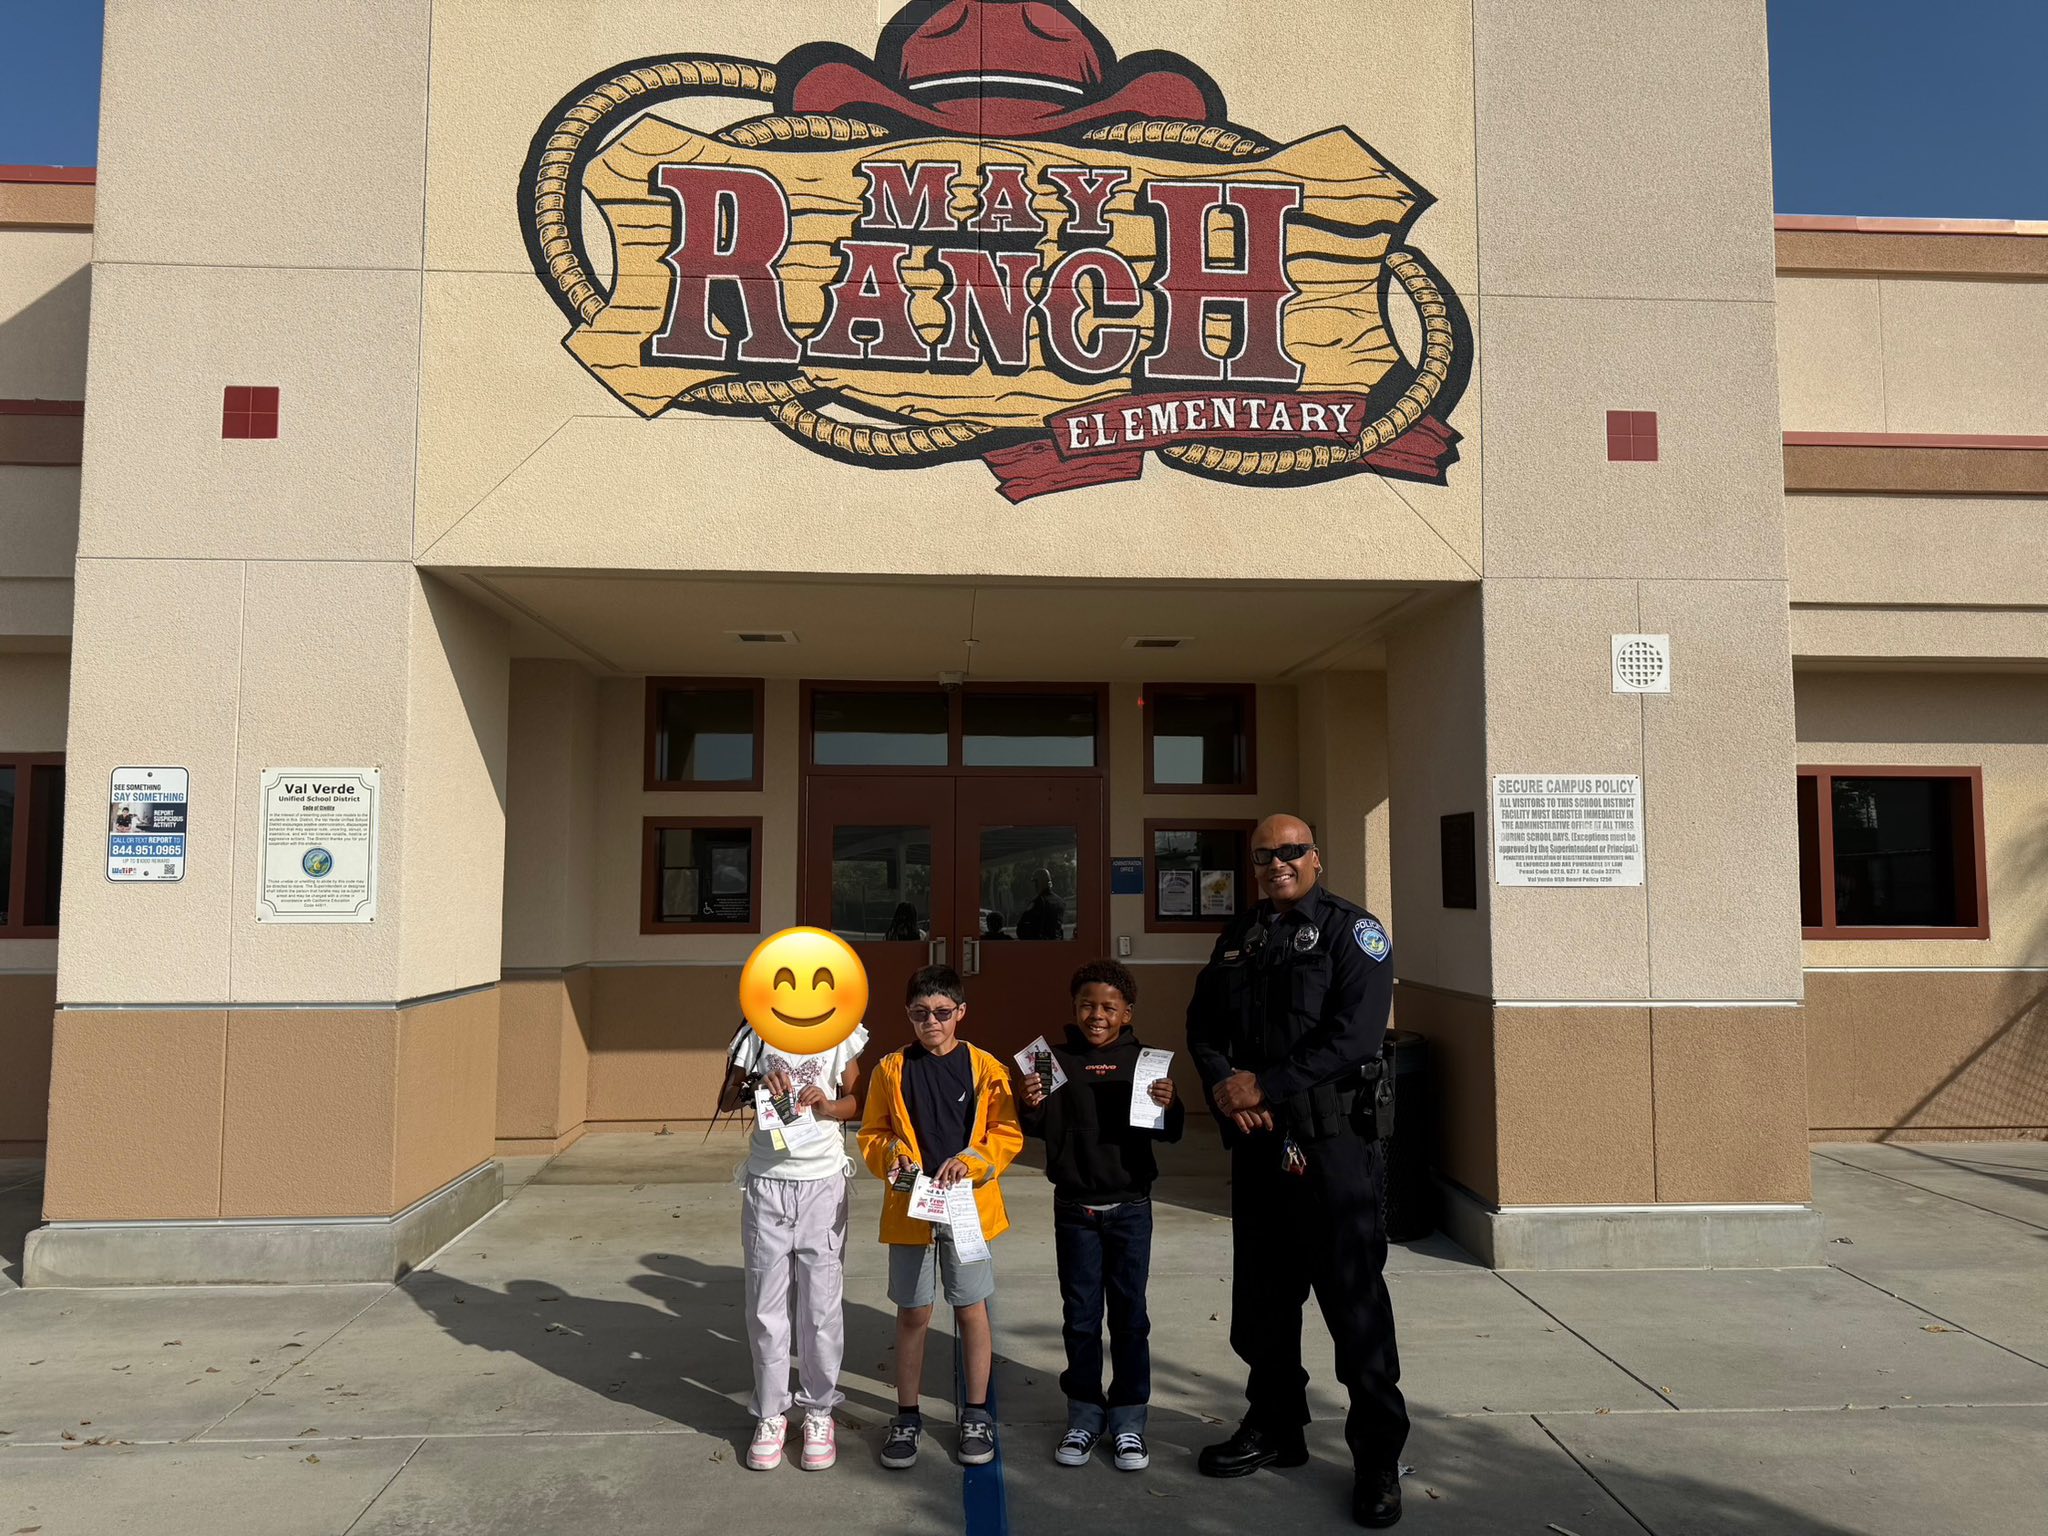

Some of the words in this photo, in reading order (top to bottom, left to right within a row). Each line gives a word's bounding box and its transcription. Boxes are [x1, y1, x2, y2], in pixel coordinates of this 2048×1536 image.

[858, 160, 1131, 235] MAY
[648, 163, 1304, 385] RANCH
[1066, 397, 1355, 450] ELEMENTARY
[284, 783, 308, 794] Val
[312, 783, 355, 794] Verde
[1498, 780, 1543, 793] SECURE
[1546, 780, 1592, 793] CAMPUS
[1595, 780, 1634, 793] POLICY
[114, 792, 130, 802] SAY
[132, 792, 184, 802] SOMETHING
[1500, 798, 1511, 808] ALL
[1512, 798, 1545, 808] VISITORS
[1546, 798, 1556, 808] TO
[1557, 798, 1573, 808] THIS
[1575, 798, 1602, 808] SCHOOL
[1603, 798, 1634, 808] DISTRICT
[1502, 809, 1530, 819] FACILITY
[1531, 809, 1550, 819] MUST
[1552, 809, 1582, 819] REGISTER
[1584, 809, 1625, 819] IMMEDIATELY
[1626, 809, 1634, 819] IN
[1502, 821, 1513, 830] THE
[1515, 821, 1570, 830] ADMINISTRATIVE
[1571, 821, 1592, 830] OFFICE
[1602, 821, 1613, 830] ALL
[1615, 821, 1634, 830] TIMES
[1501, 832, 1525, 842] DURING
[1526, 832, 1552, 842] SCHOOL
[1553, 832, 1570, 842] DAYS.
[1571, 832, 1609, 842] (Exceptions
[1610, 832, 1626, 842] must
[1627, 832, 1636, 842] be
[112, 845, 182, 856] 844.951.0965
[1499, 844, 1528, 854] approved
[1530, 844, 1537, 854] by
[1538, 844, 1548, 854] the
[1550, 844, 1598, 854] Superintendent
[1600, 844, 1606, 854] or
